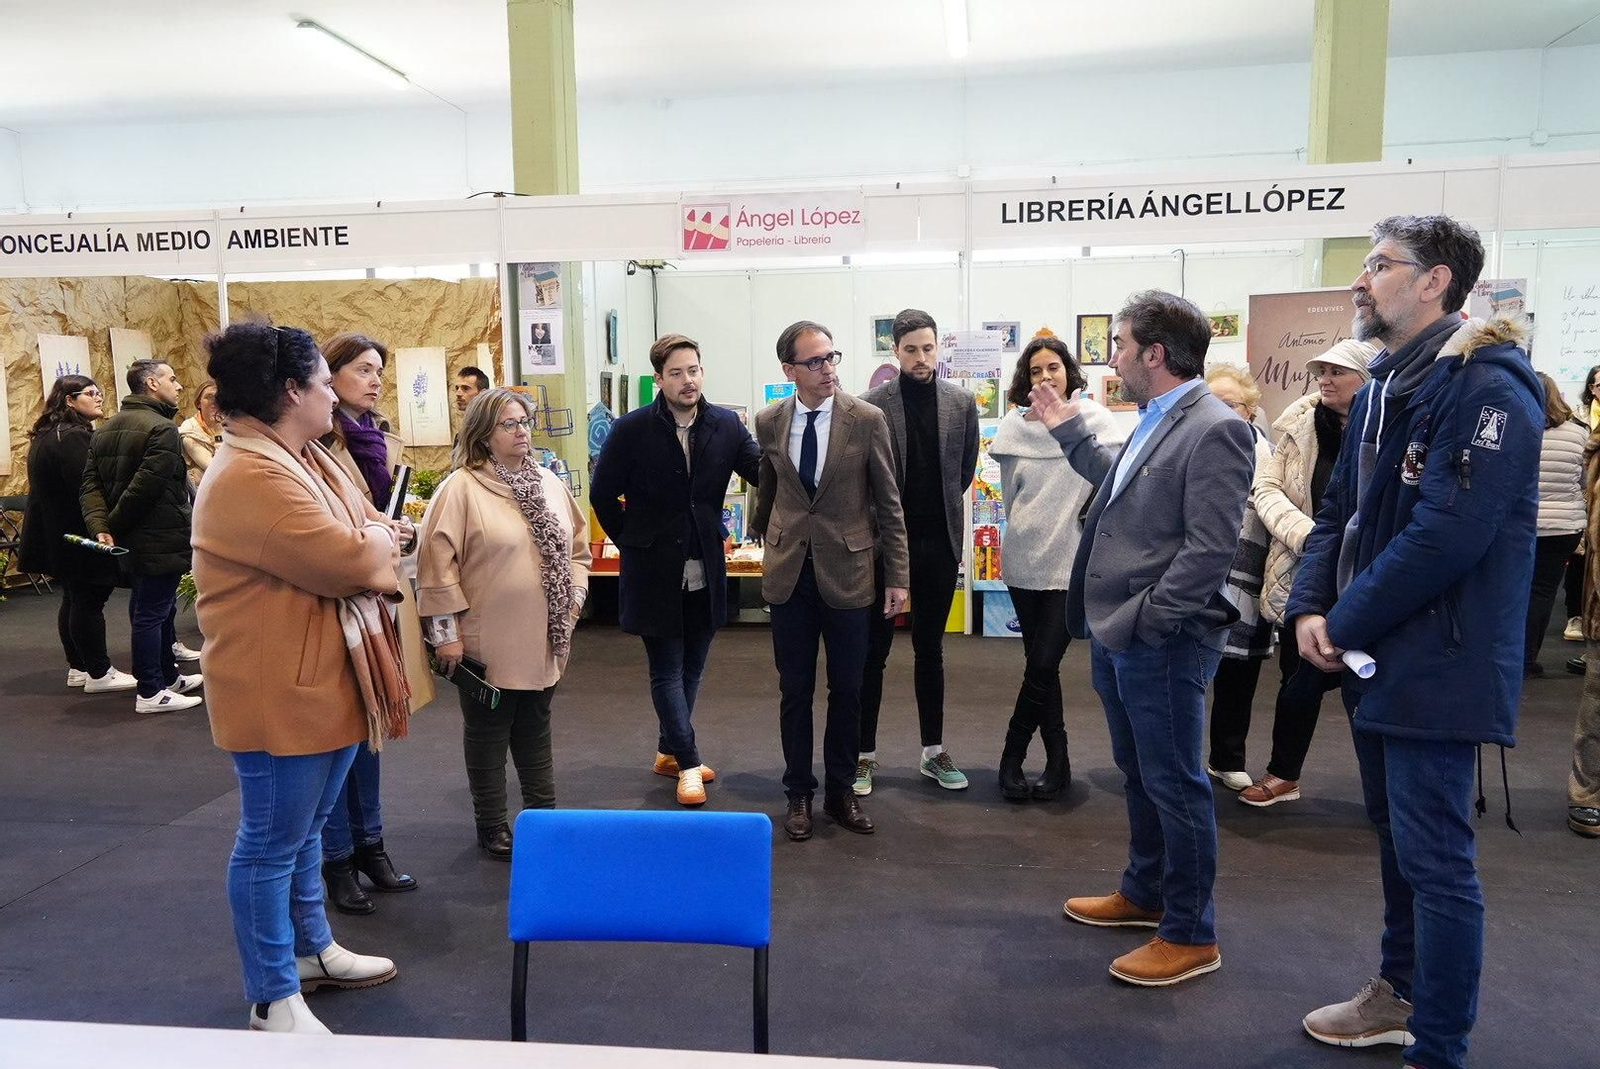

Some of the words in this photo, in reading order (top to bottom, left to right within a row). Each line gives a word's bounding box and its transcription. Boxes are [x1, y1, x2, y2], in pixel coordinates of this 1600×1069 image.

[1001, 192, 1135, 224] LIBRERÍA
[1138, 190, 1242, 219] ÁNGEL
[1245, 184, 1346, 213] LÓPEZ
[736, 205, 794, 231] Ángel
[801, 206, 861, 229] López
[0, 228, 129, 255] ONCEJALÍA
[136, 229, 211, 252] MEDIO
[227, 226, 349, 250] AMBIENTE
[736, 236, 785, 248] Papelería
[794, 235, 832, 246] Librería
[1307, 305, 1345, 314] EDELVIVES
[1278, 331, 1327, 349] Antonio
